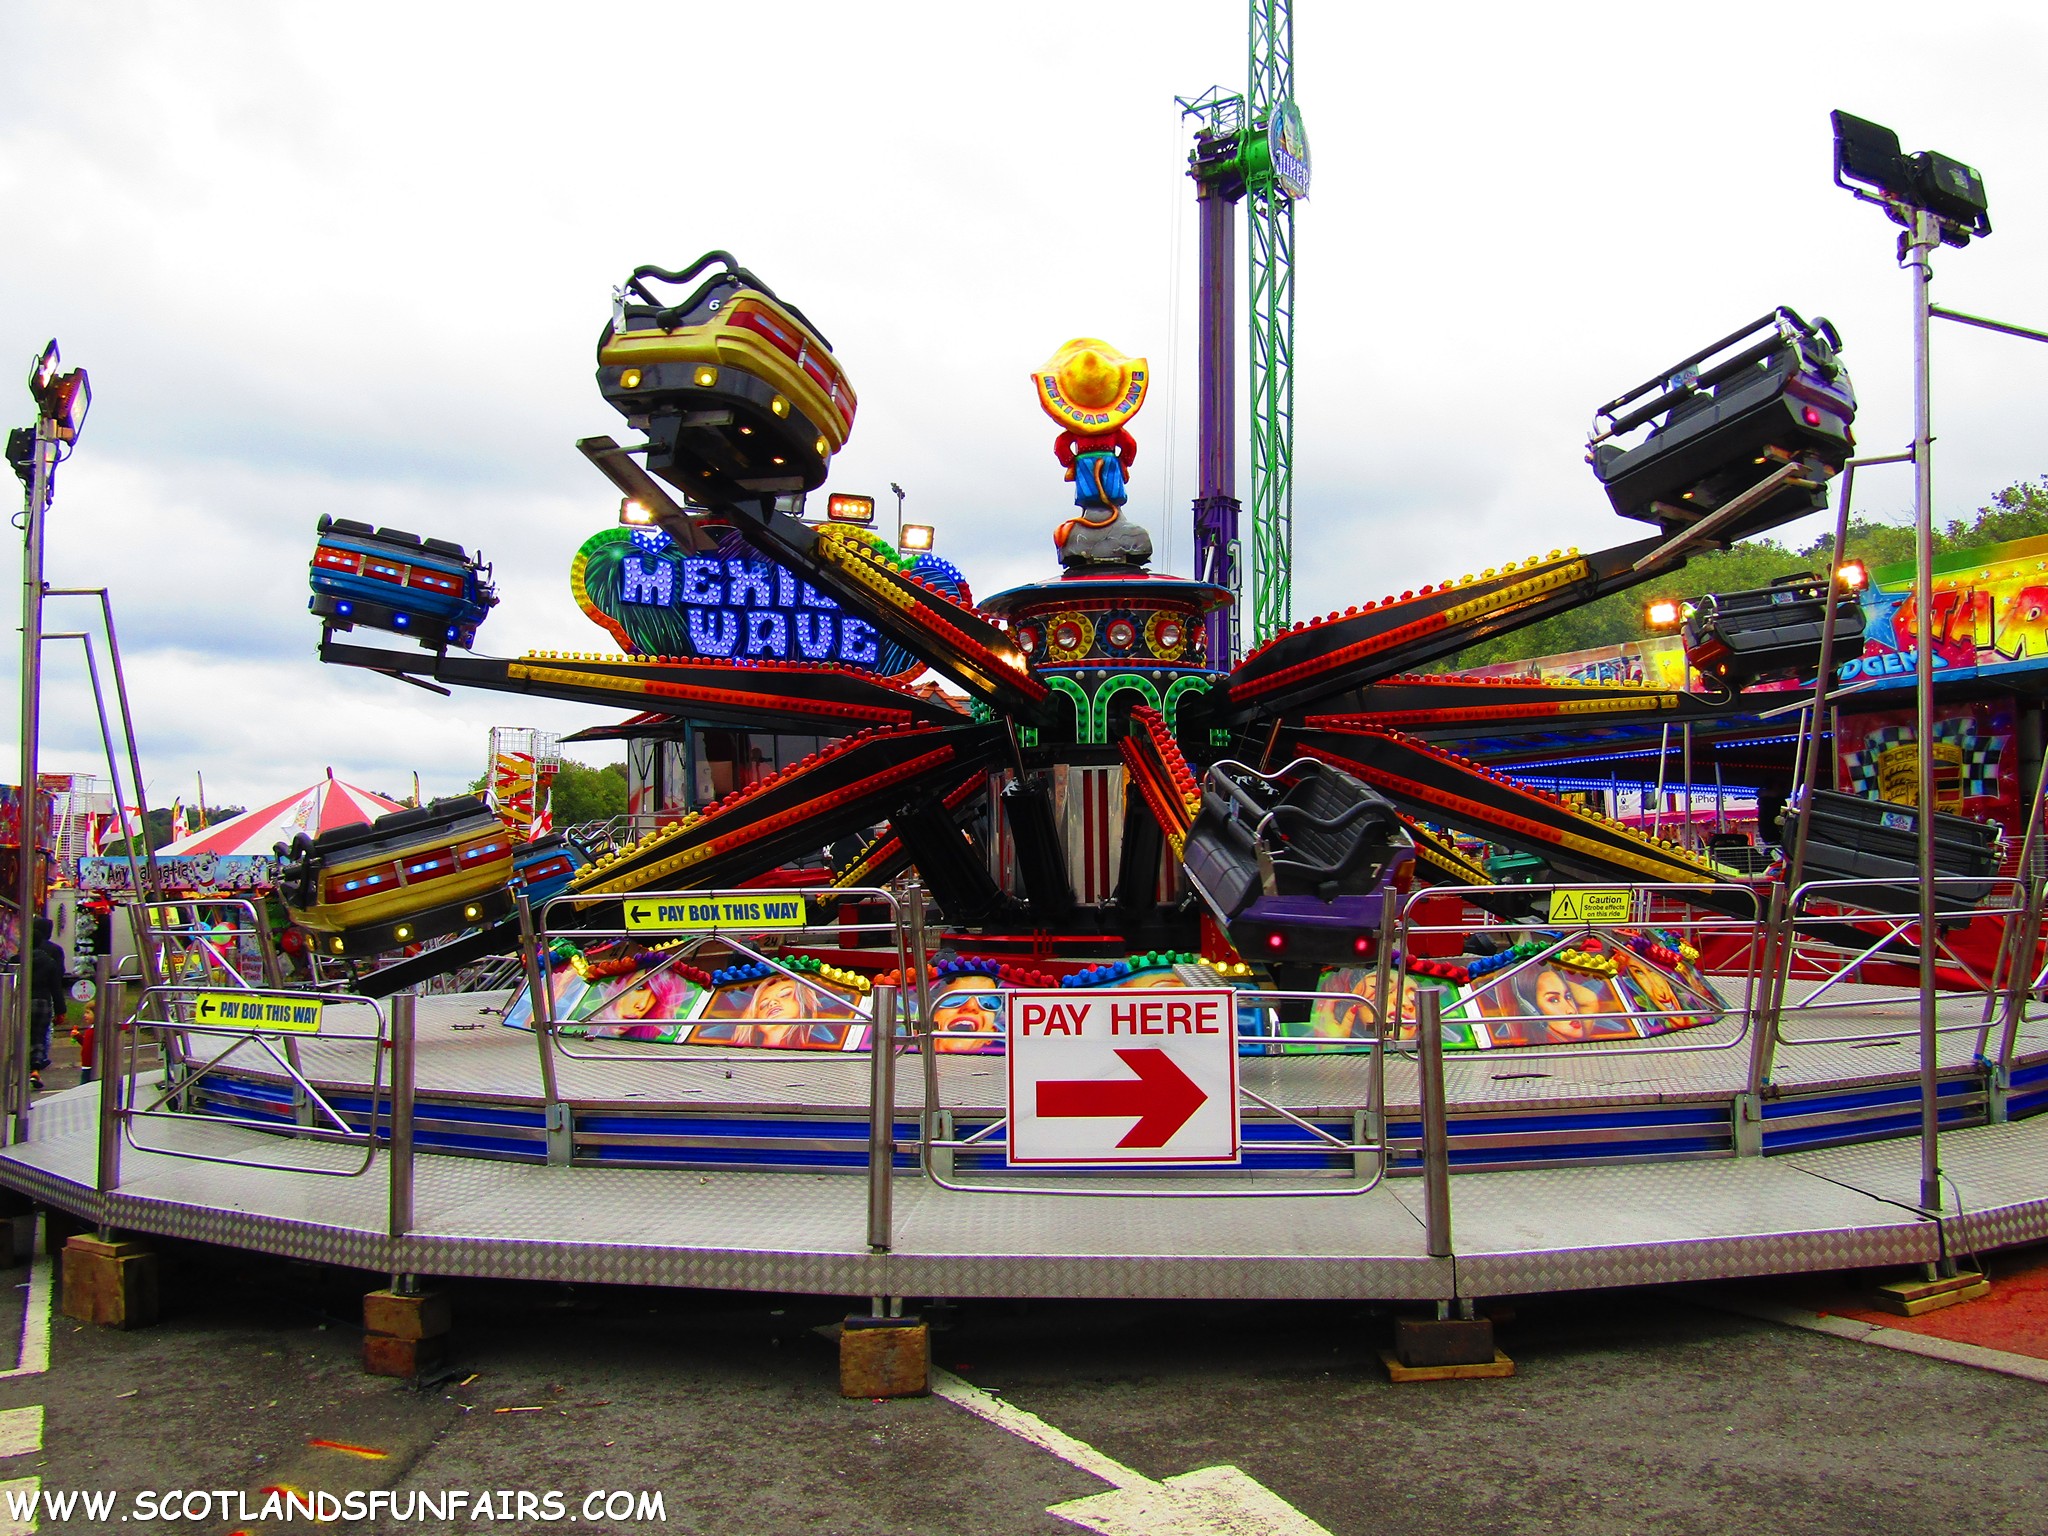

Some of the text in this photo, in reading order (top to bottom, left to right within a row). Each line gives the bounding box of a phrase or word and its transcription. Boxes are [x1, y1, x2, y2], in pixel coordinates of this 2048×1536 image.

[709, 299, 720, 311] 6
[1043, 371, 1144, 425] MEXICAN WAVE
[687, 608, 878, 664] WAVE
[1369, 863, 1382, 878] 7
[1589, 896, 1622, 904] Caution
[657, 902, 799, 922] PAY BOX THIS WAY
[764, 935, 778, 947] 24
[220, 1002, 318, 1024] PAY BOX THIS WAY
[1022, 1002, 1220, 1036] PAY HERE
